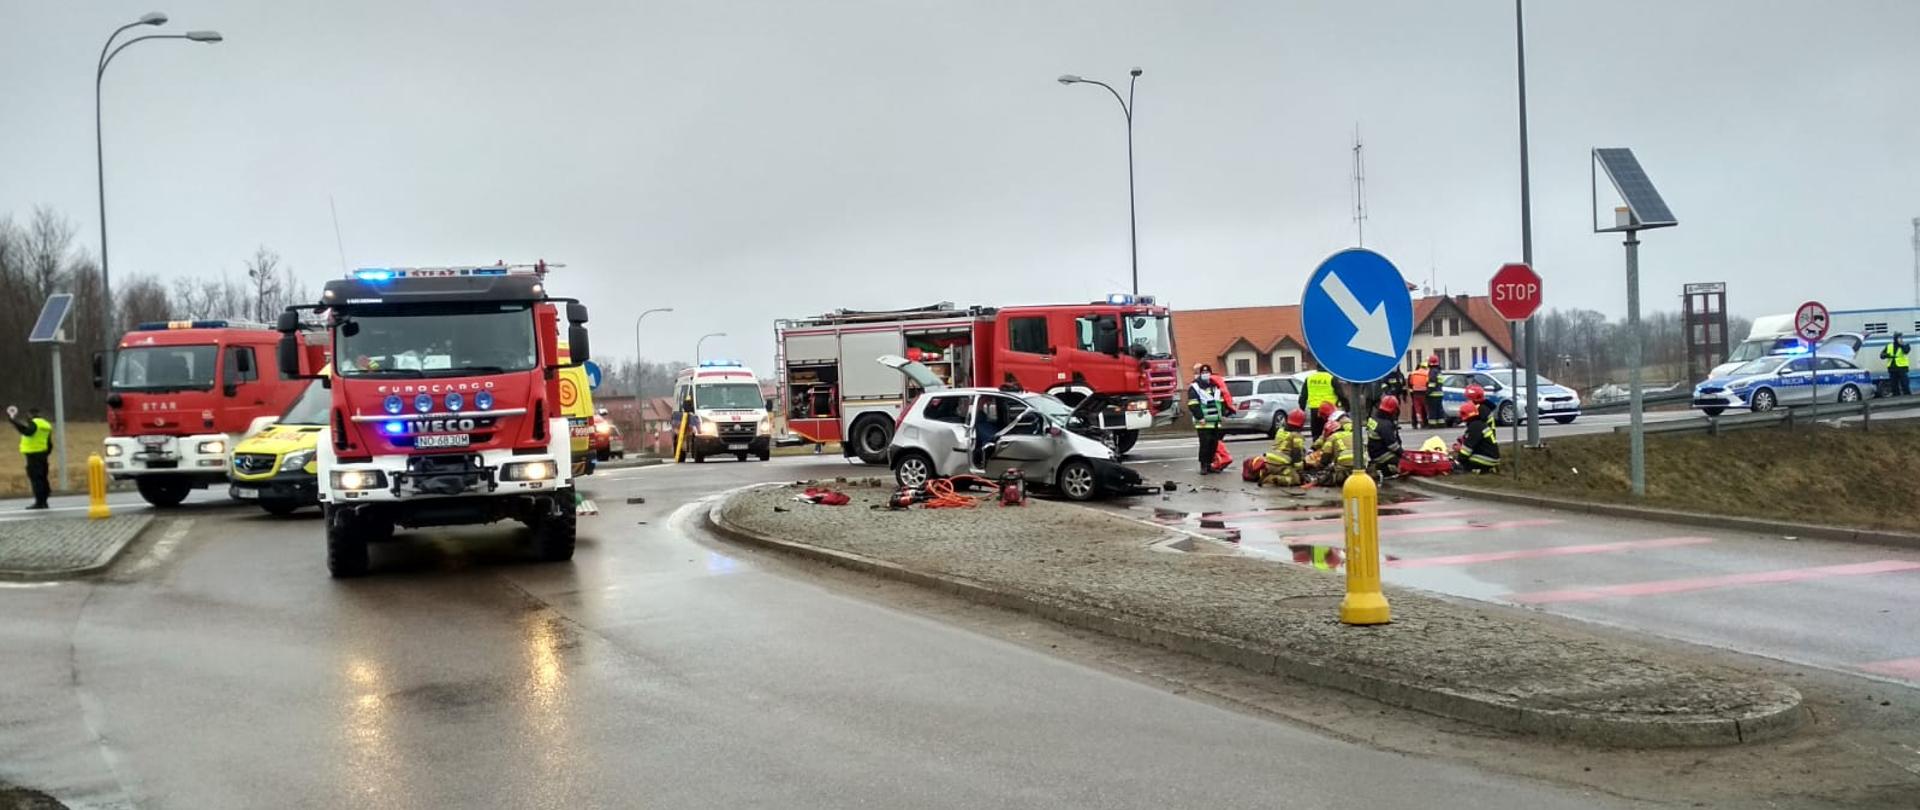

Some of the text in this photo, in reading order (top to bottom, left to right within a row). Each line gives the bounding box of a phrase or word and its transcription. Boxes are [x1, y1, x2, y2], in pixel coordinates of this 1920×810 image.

[1496, 283, 1537, 301] STOP
[378, 381, 495, 393] EUROCARGO
[142, 402, 177, 411] STAR
[406, 419, 475, 433] IVECO
